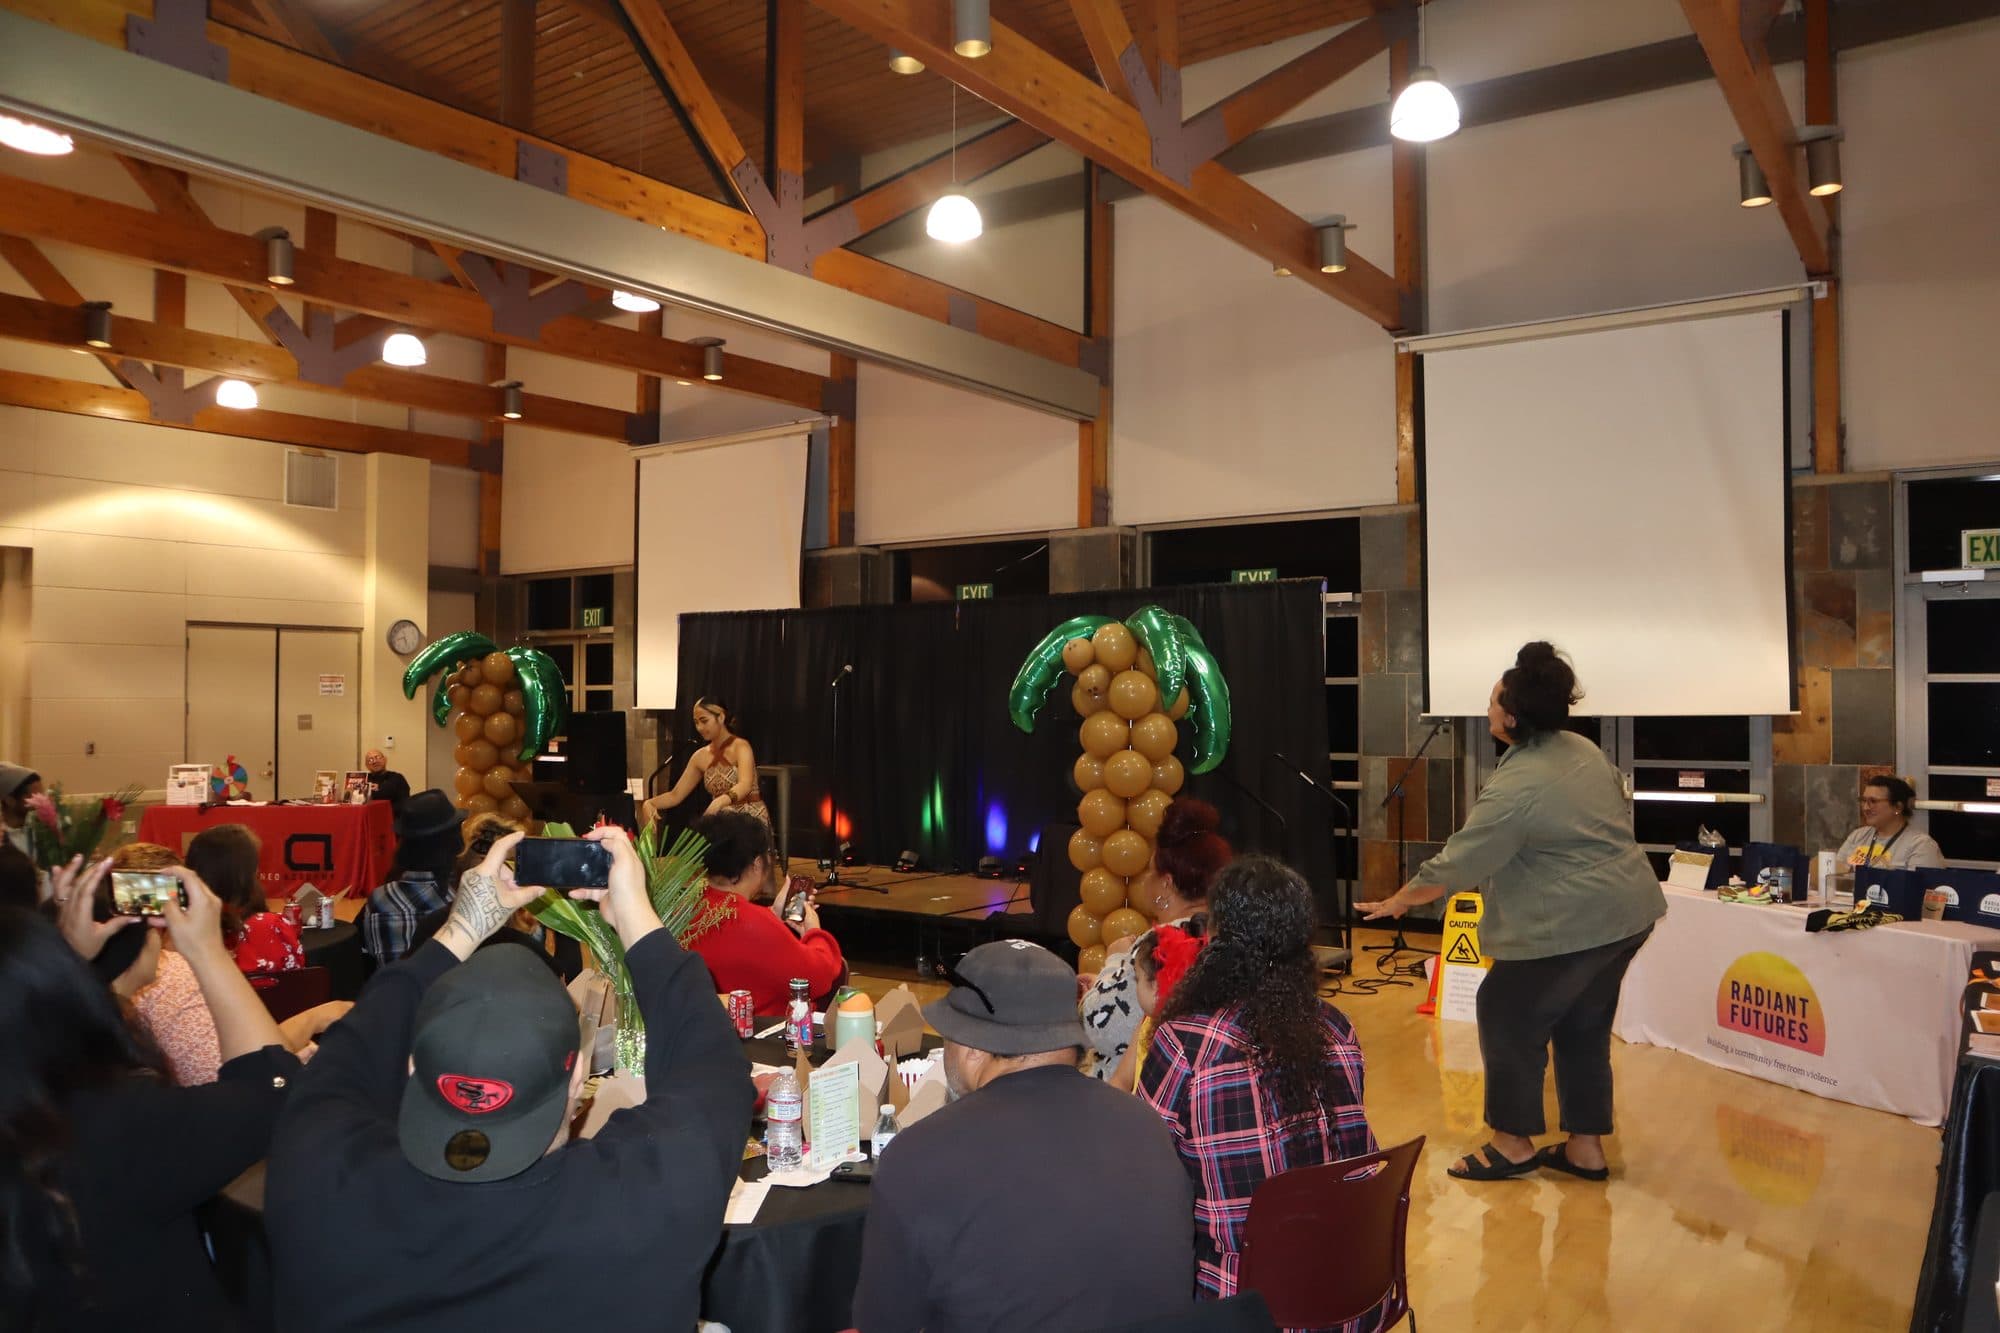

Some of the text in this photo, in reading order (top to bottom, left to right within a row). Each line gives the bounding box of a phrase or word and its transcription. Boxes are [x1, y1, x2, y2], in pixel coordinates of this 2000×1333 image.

[583, 608, 601, 627] EXIT
[1731, 980, 1809, 1019] RADIANT
[1730, 1004, 1809, 1044] FUTURES
[1735, 1048, 1772, 1067] community
[1773, 1059, 1787, 1070] free
[1787, 1063, 1806, 1077] from
[1806, 1069, 1839, 1087] violence
